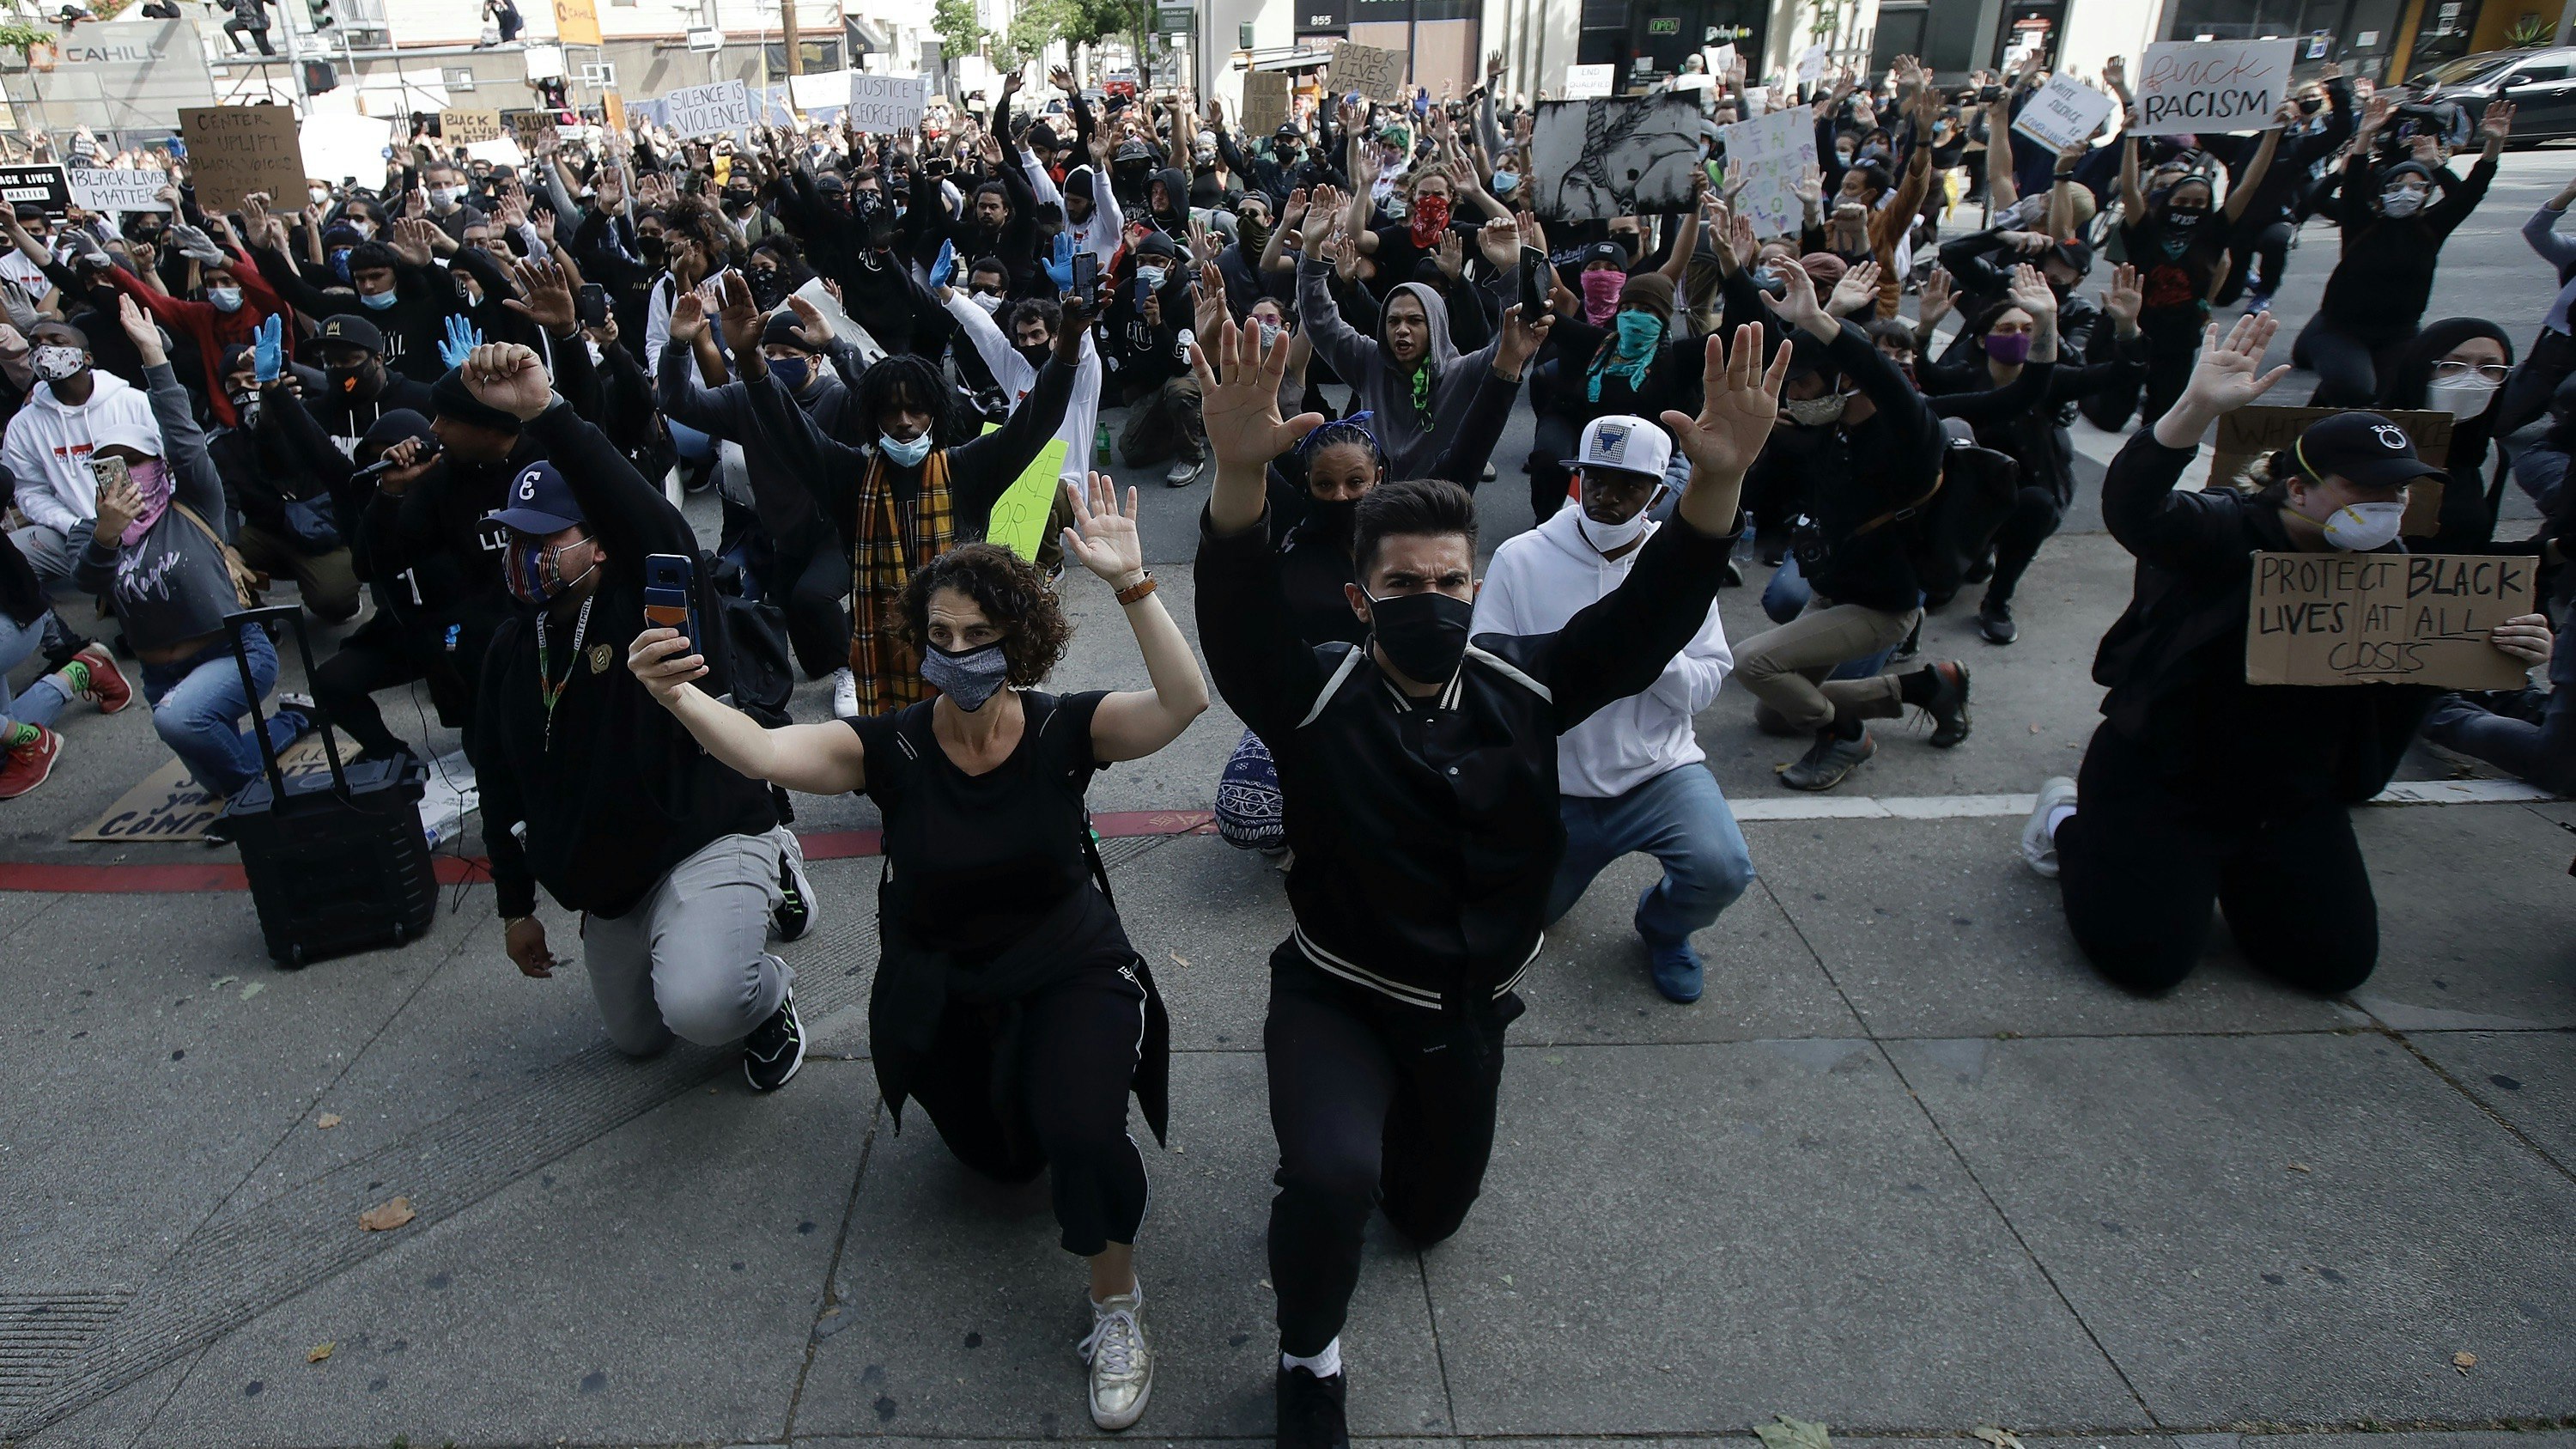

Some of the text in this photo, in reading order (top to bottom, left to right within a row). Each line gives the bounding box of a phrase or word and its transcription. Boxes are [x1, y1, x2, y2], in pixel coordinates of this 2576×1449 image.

[1311, 15, 1331, 26] 855
[1651, 19, 1678, 32] OPEN
[1310, 38, 1328, 46] 855
[66, 45, 166, 62] CAHILL
[1340, 45, 1395, 66] BLACK
[1339, 61, 1388, 83] LIVES
[1581, 68, 1601, 76] END
[856, 76, 925, 102] JUSTICE 4
[1328, 76, 1394, 99] MATTER
[1569, 80, 1612, 88] QUALIFIED
[2050, 81, 2077, 101] WHITE
[670, 82, 744, 112] SILENCE IS
[849, 101, 894, 127] GEORGE
[2048, 99, 2085, 125] SILENCE
[2146, 88, 2269, 125] RACISM
[197, 113, 270, 131] CENTER
[445, 113, 489, 125] BLACK
[675, 102, 749, 133] VIOLENCE
[464, 126, 499, 135] LIVES
[217, 135, 279, 152] UPLIFT
[191, 156, 234, 170] BLACK
[0, 174, 55, 185] ACK LIVES
[76, 170, 167, 186] BLACK LIVES
[7, 191, 45, 200] MATTER
[91, 189, 155, 206] MATTER
[209, 186, 279, 205] STU
[519, 471, 542, 500] E
[2261, 557, 2522, 600] PROTECT BLACK
[2261, 603, 2488, 636] LIVES AT ALL
[2329, 642, 2433, 671] COSTS
